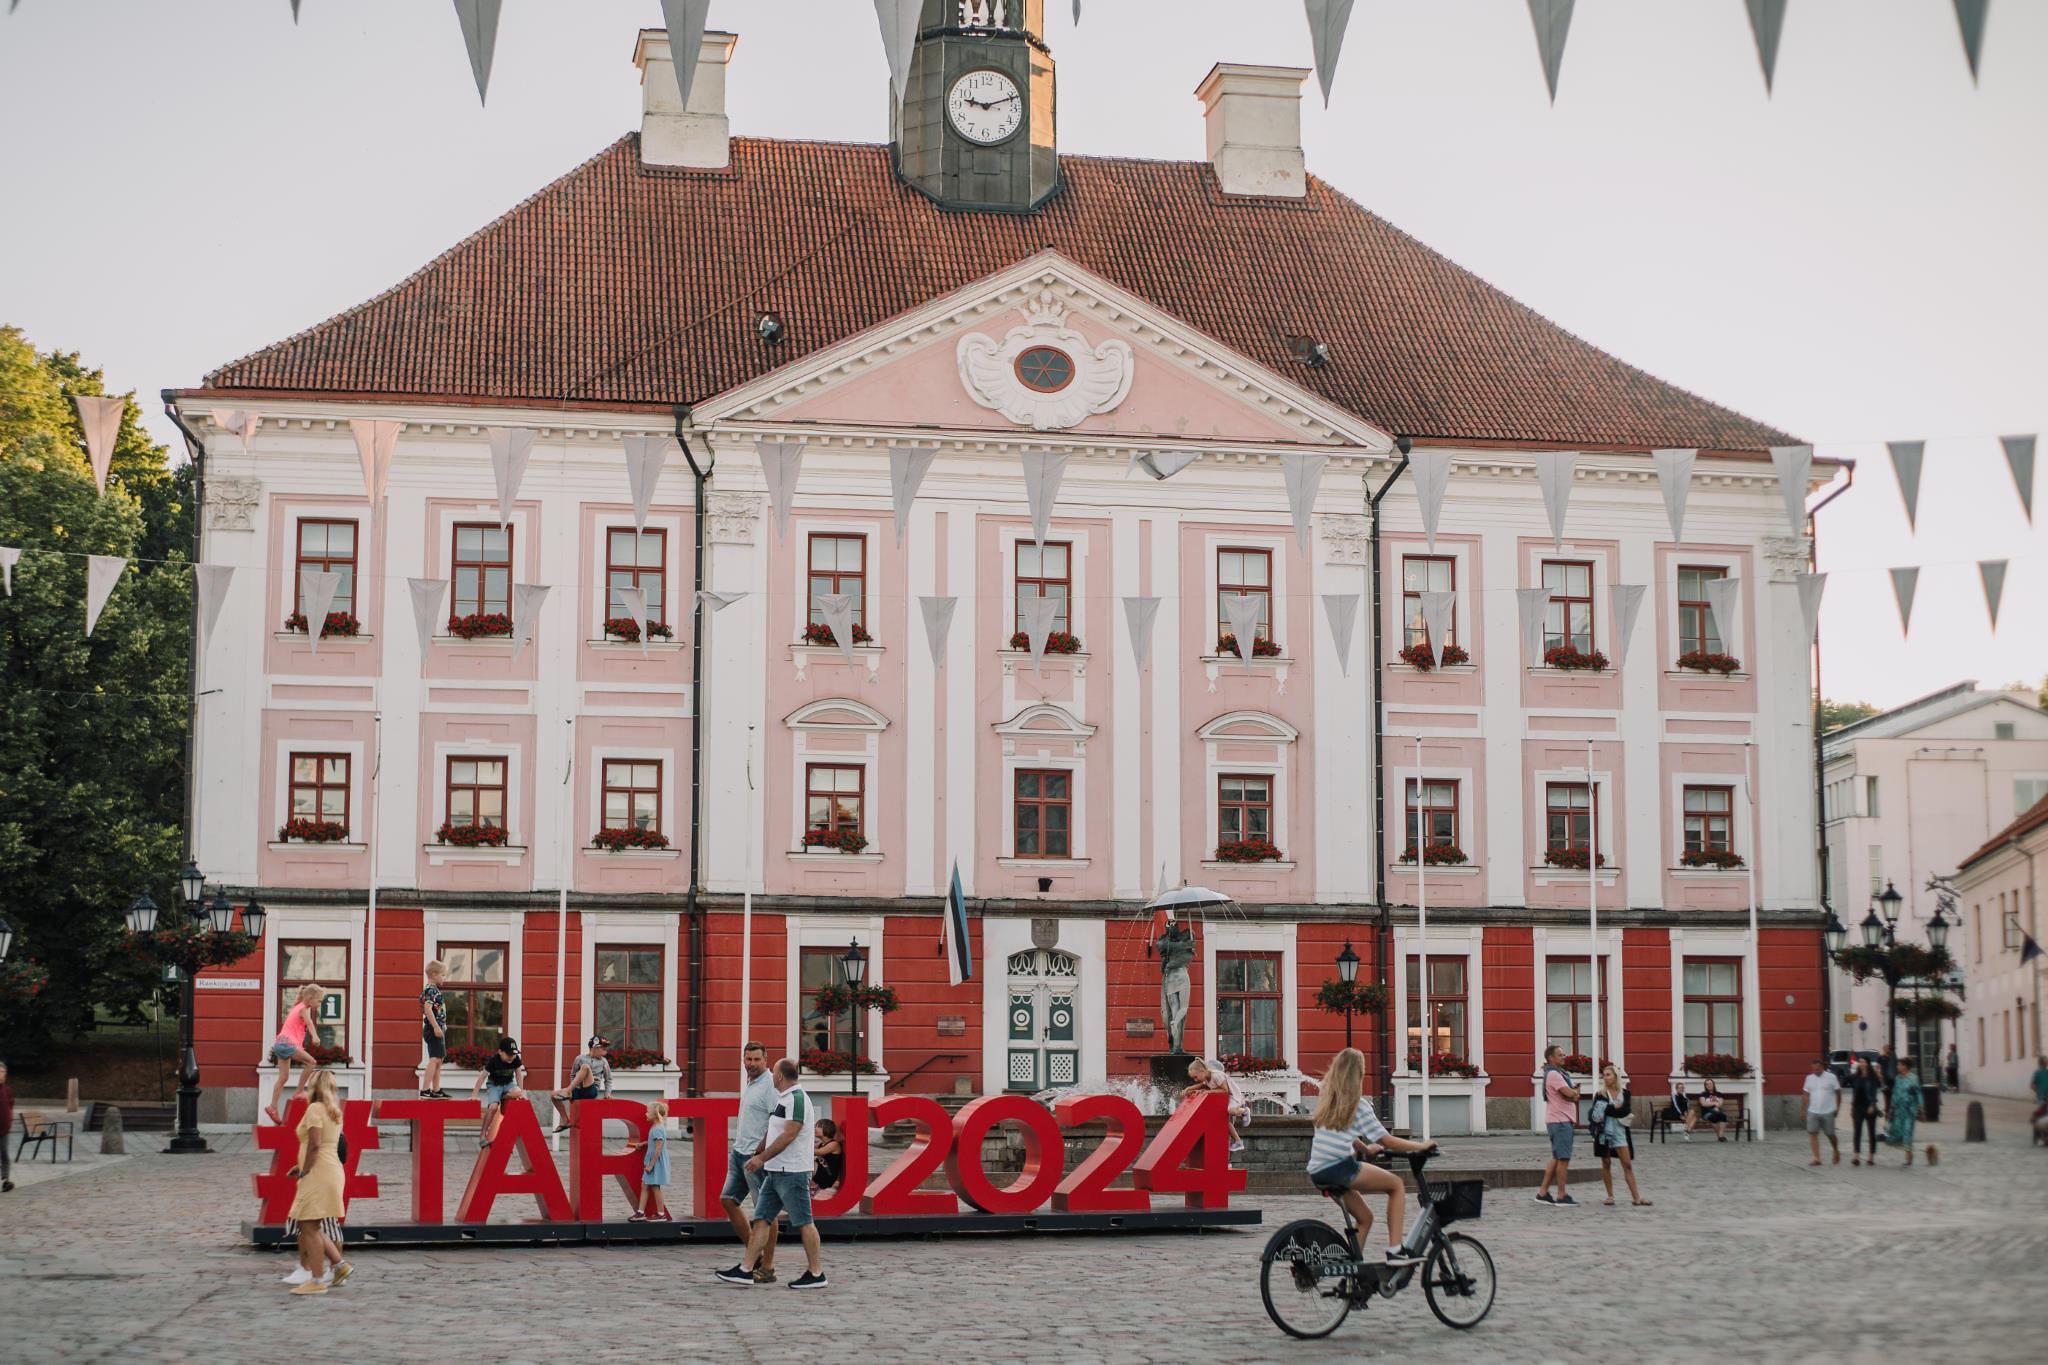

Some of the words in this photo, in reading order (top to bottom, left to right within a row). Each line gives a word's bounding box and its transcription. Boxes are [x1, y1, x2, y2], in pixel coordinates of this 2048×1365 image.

[969, 79, 978, 89] 11
[981, 76, 992, 86] 12
[960, 88, 971, 98] 10
[954, 100, 962, 109] 9
[1010, 103, 1018, 113] 3
[958, 113, 966, 122] 8
[1005, 114, 1012, 125] 4
[968, 122, 975, 132] 7
[998, 124, 1007, 135] 5
[981, 128, 990, 138] 6
